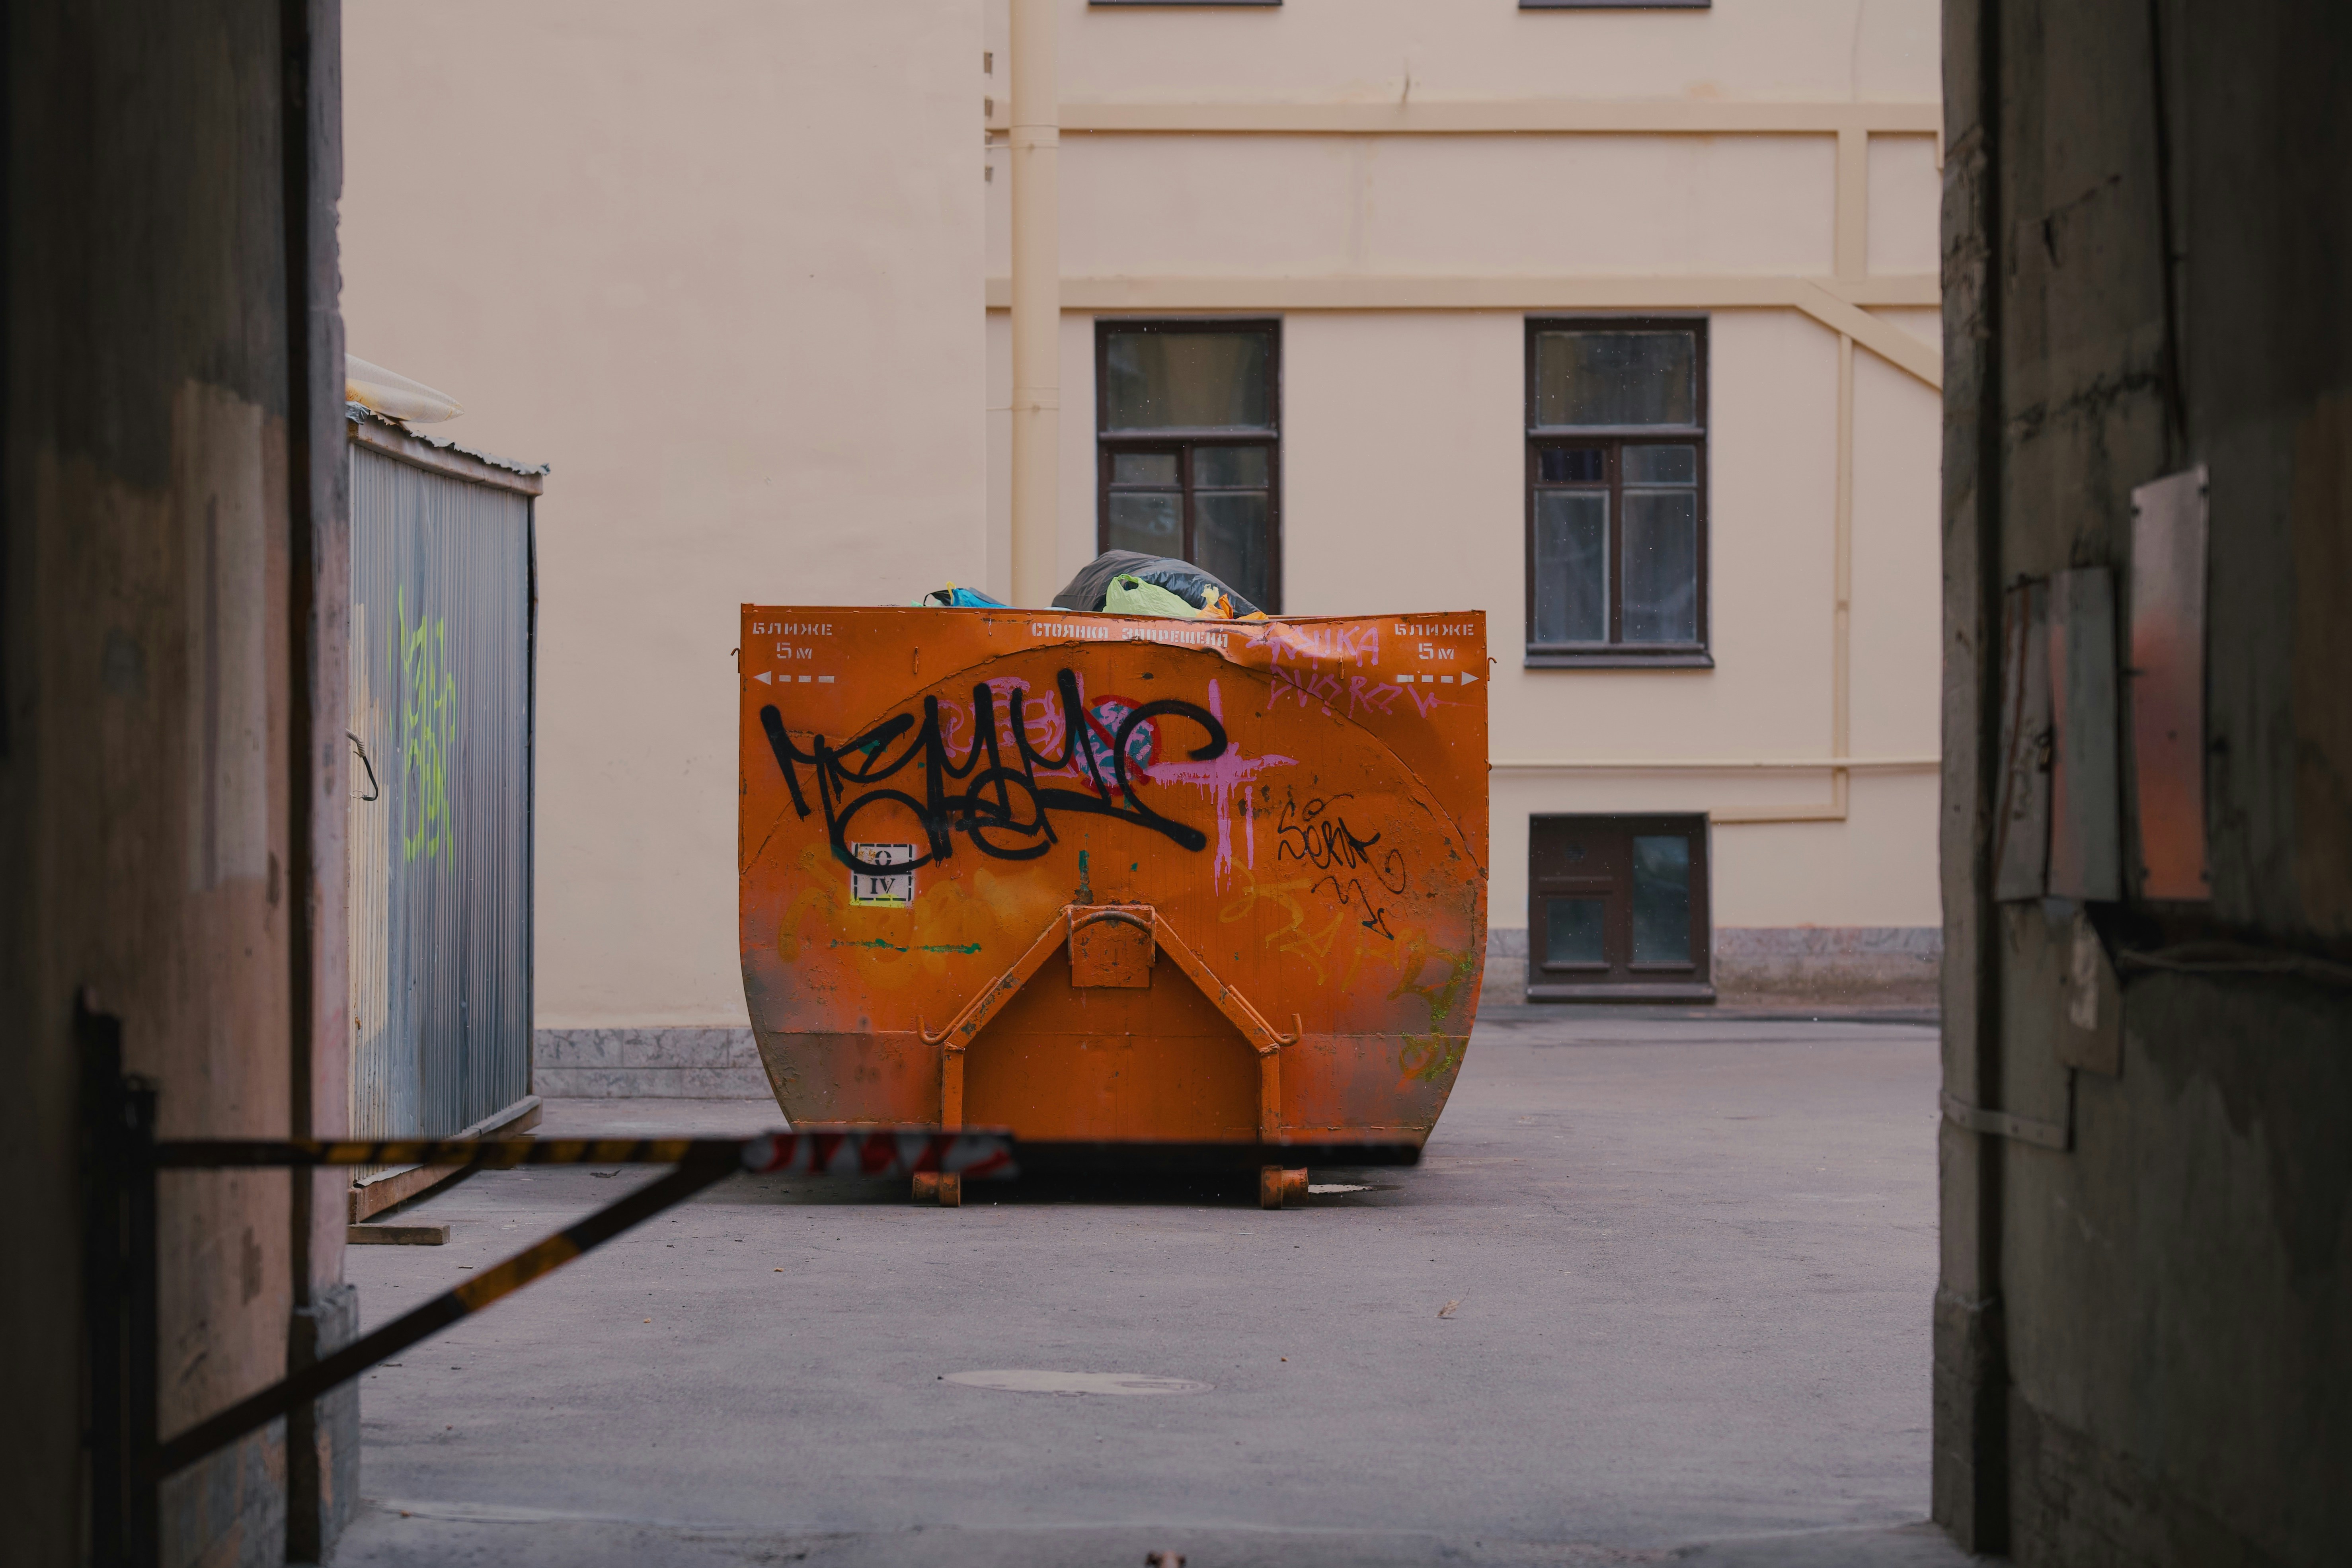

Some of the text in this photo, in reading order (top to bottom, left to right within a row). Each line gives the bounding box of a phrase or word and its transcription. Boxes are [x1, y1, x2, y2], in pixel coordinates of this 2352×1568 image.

[752, 622, 833, 636] БЛИЖЕ
[1032, 622, 1229, 648] СТОЯНКА ЗАПРЕЩЕНА
[1394, 623, 1474, 636] БЛИЖЕ
[870, 878, 896, 894] IV
